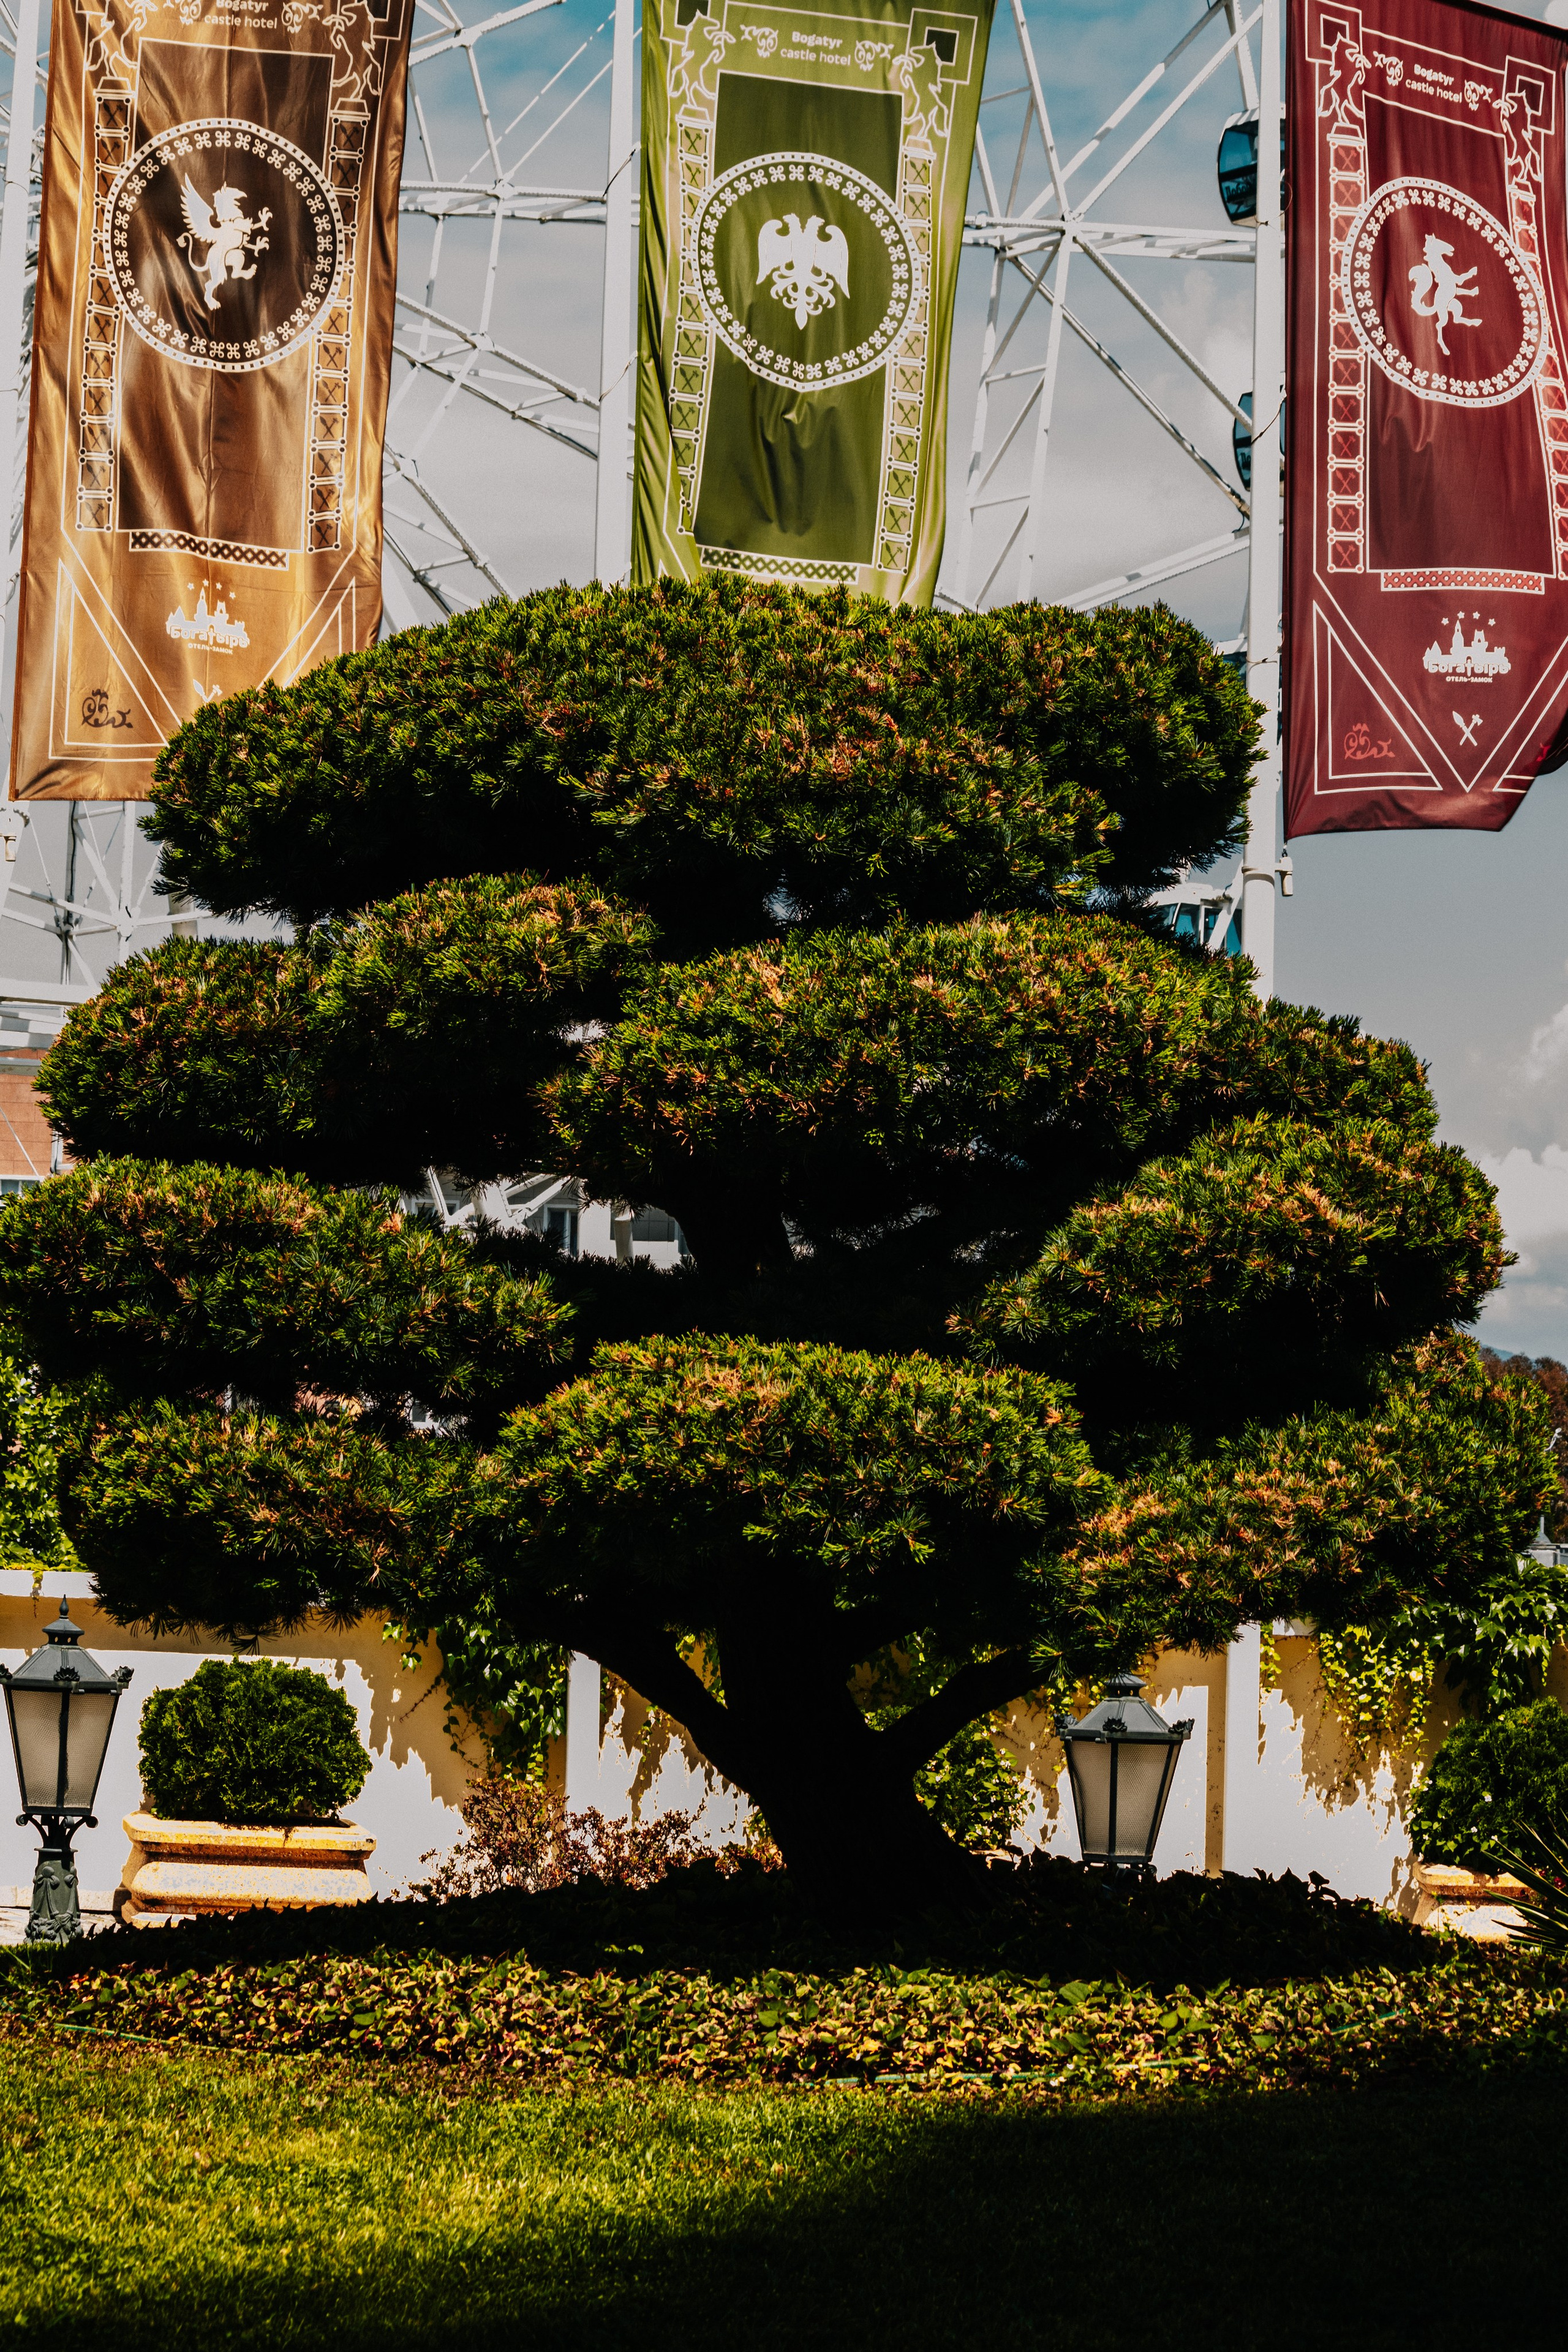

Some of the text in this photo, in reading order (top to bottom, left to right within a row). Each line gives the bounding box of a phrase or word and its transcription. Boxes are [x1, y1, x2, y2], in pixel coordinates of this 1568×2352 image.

[216, 0, 269, 13] Bogatyr
[204, 14, 277, 29] castle hotel
[792, 31, 843, 50] Bogatyr
[780, 48, 851, 66] castle hotel
[1414, 64, 1454, 86] Bogatyr
[1406, 78, 1463, 103] castle hotel
[170, 625, 249, 649] Богатырь
[1428, 659, 1510, 677] Богатырь
